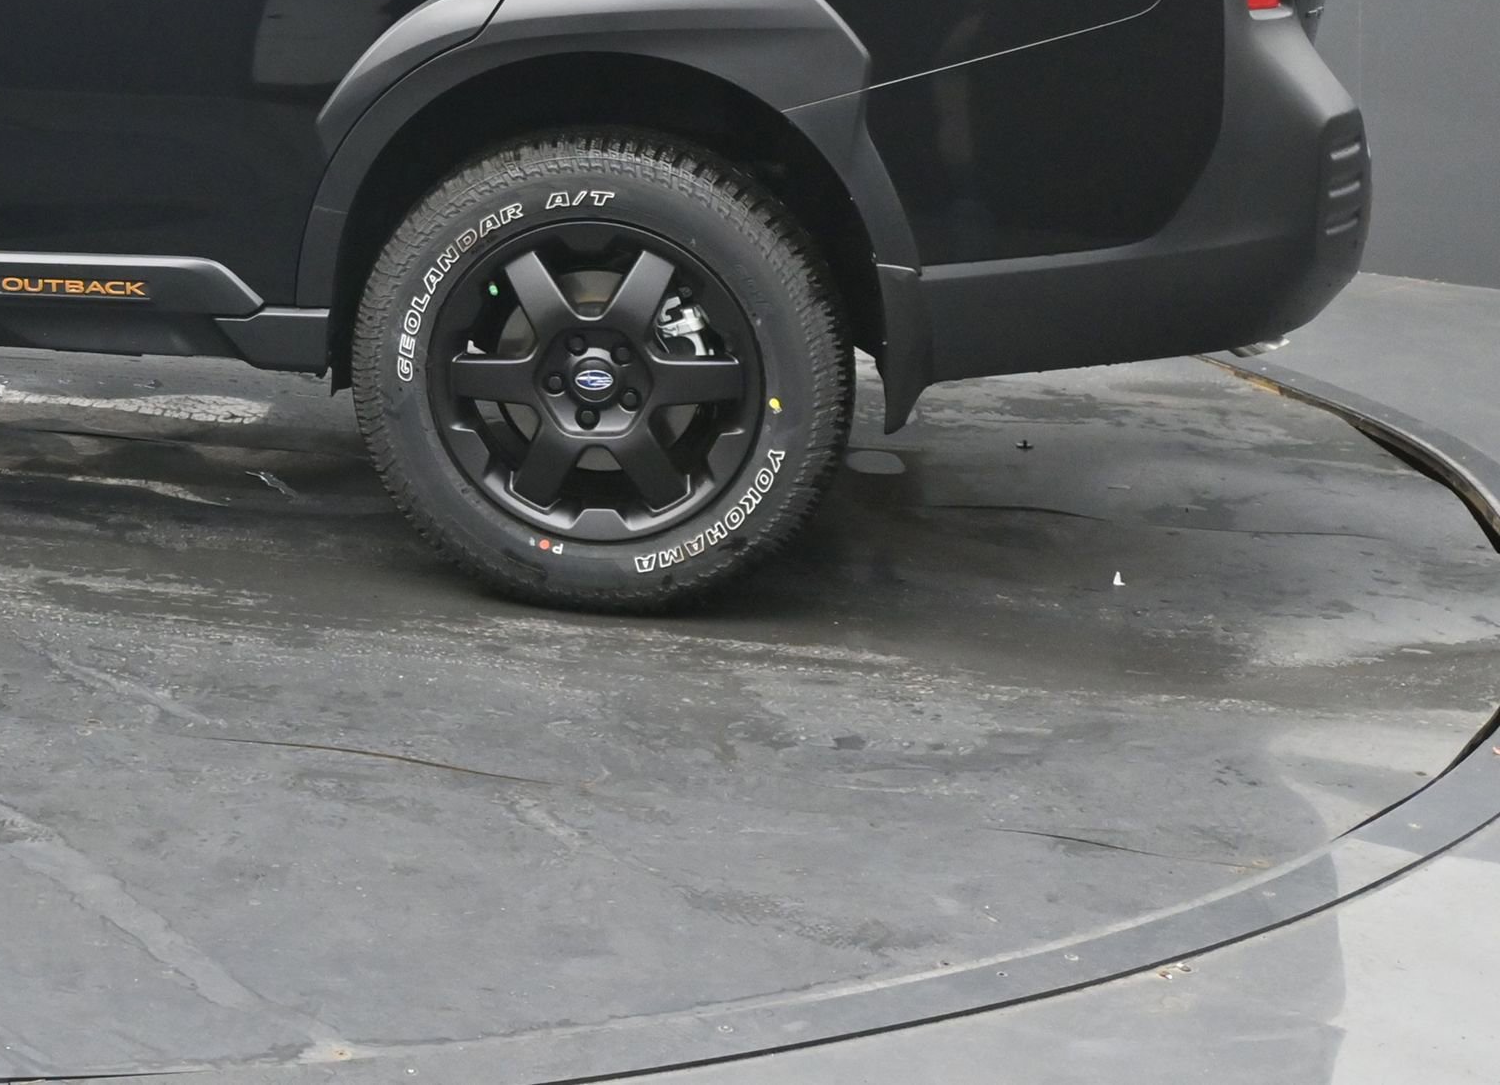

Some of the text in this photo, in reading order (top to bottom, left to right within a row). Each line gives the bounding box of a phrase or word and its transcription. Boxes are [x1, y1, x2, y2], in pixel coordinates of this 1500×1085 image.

[1, 276, 146, 296] OUTBACK
[396, 189, 616, 382] GEOLANDAR A/T
[634, 447, 787, 574] YOKOHAMA
